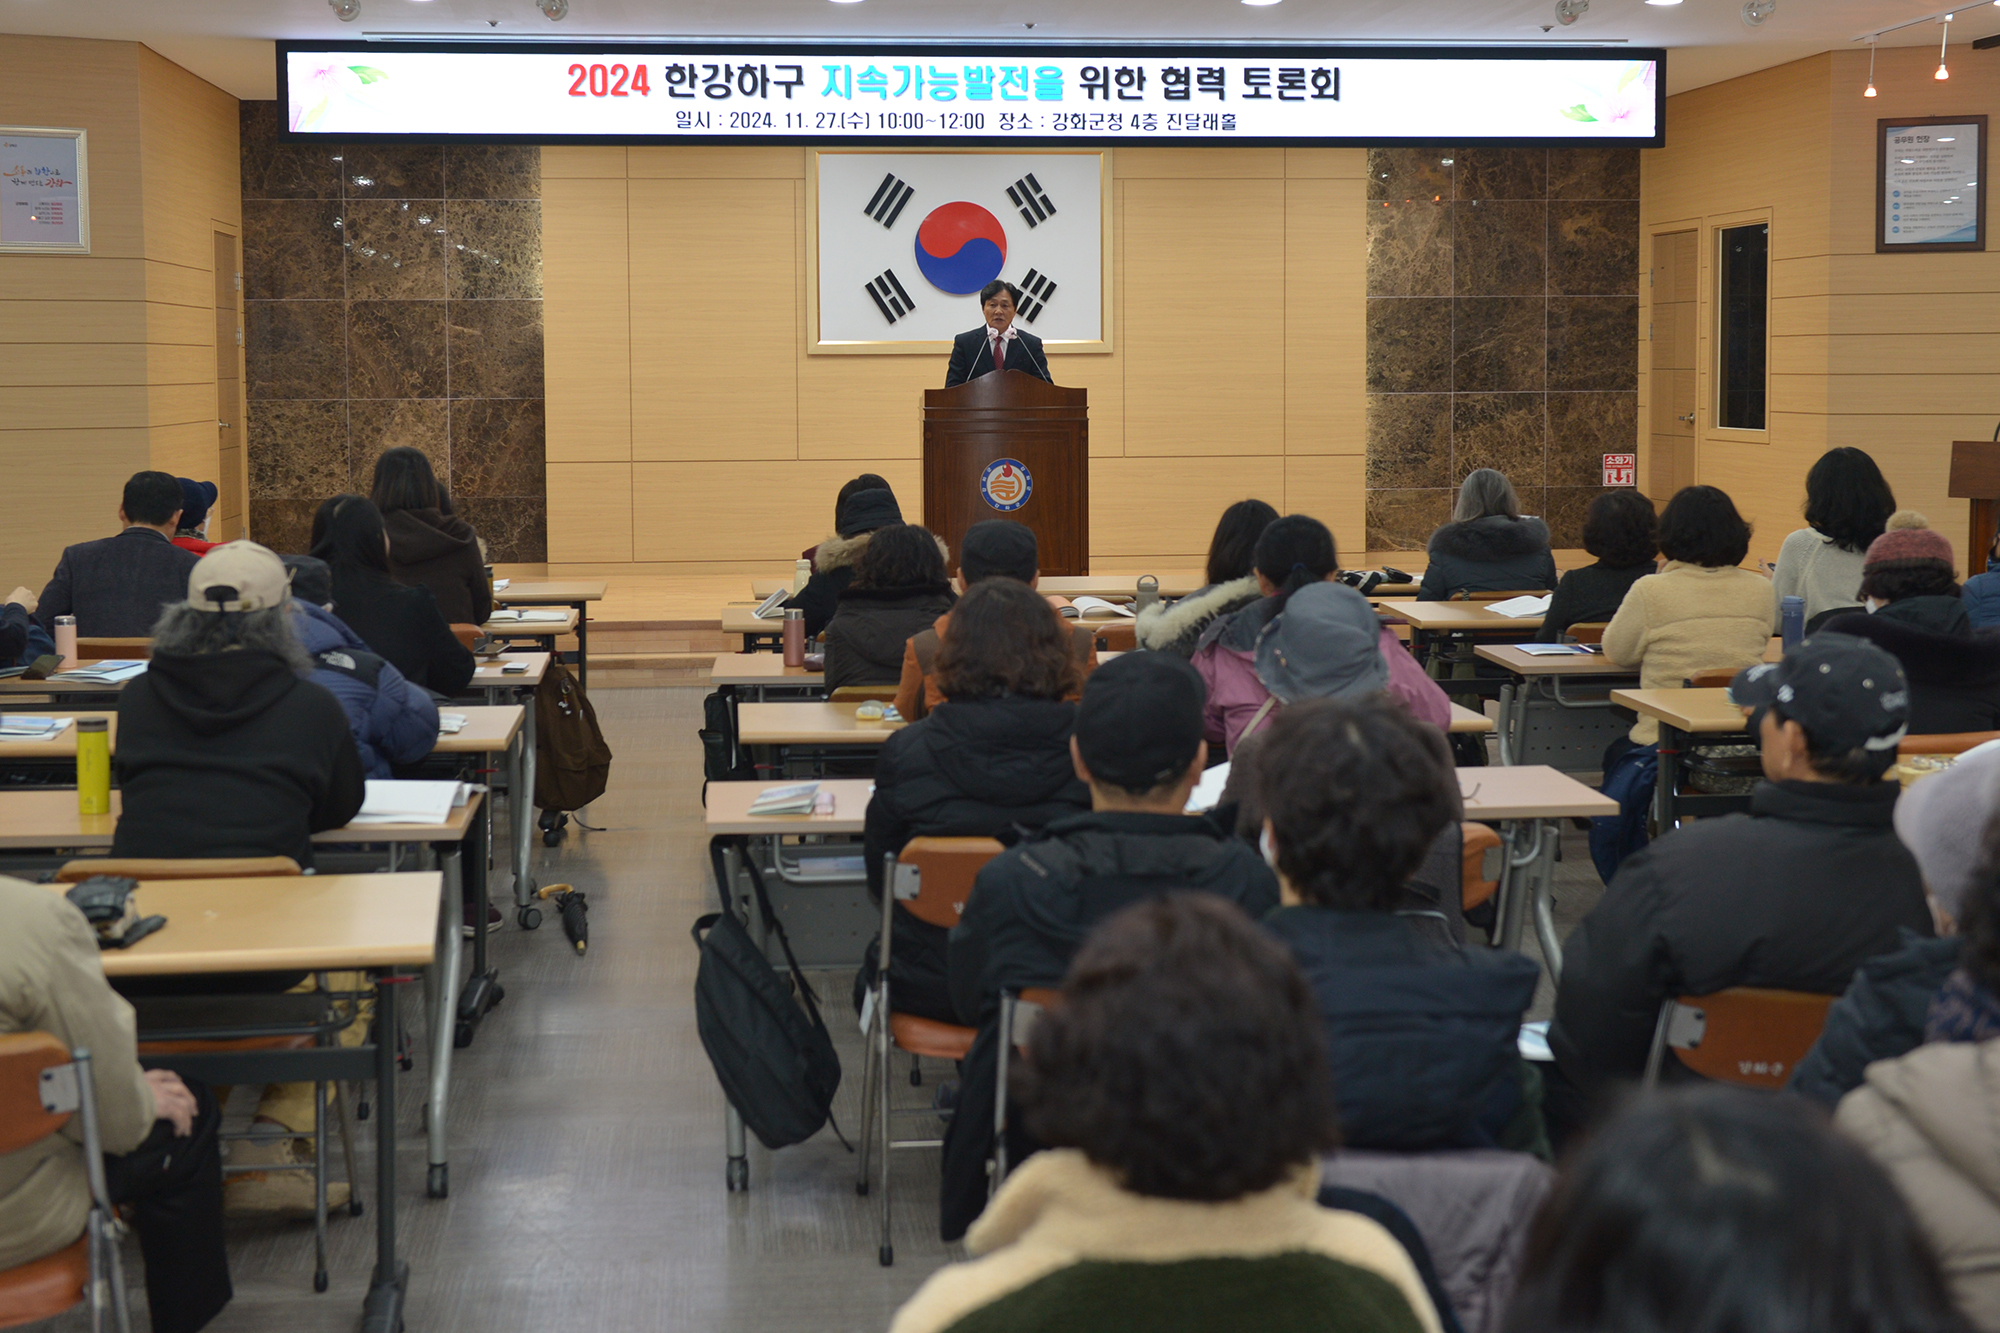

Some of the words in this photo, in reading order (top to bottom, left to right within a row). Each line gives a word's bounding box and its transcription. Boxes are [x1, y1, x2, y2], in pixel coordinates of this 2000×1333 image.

[568, 64, 650, 97] 2024
[665, 63, 803, 100] 한강하구
[820, 65, 1064, 101] 지속가능발전을
[1080, 66, 1146, 101] 위한
[1161, 66, 1225, 101] 협력
[1242, 67, 1340, 101] 토론회
[676, 110, 711, 129] 일시
[730, 111, 777, 129] 2024.
[785, 112, 809, 129] 11.
[878, 112, 985, 130] 10:00~12:00
[999, 112, 1032, 131] 장소
[1053, 112, 1122, 131] 강화군청
[1130, 112, 1157, 131] 4층
[1167, 112, 1237, 131] 진달래홀
[1606, 456, 1632, 464] 소화기
